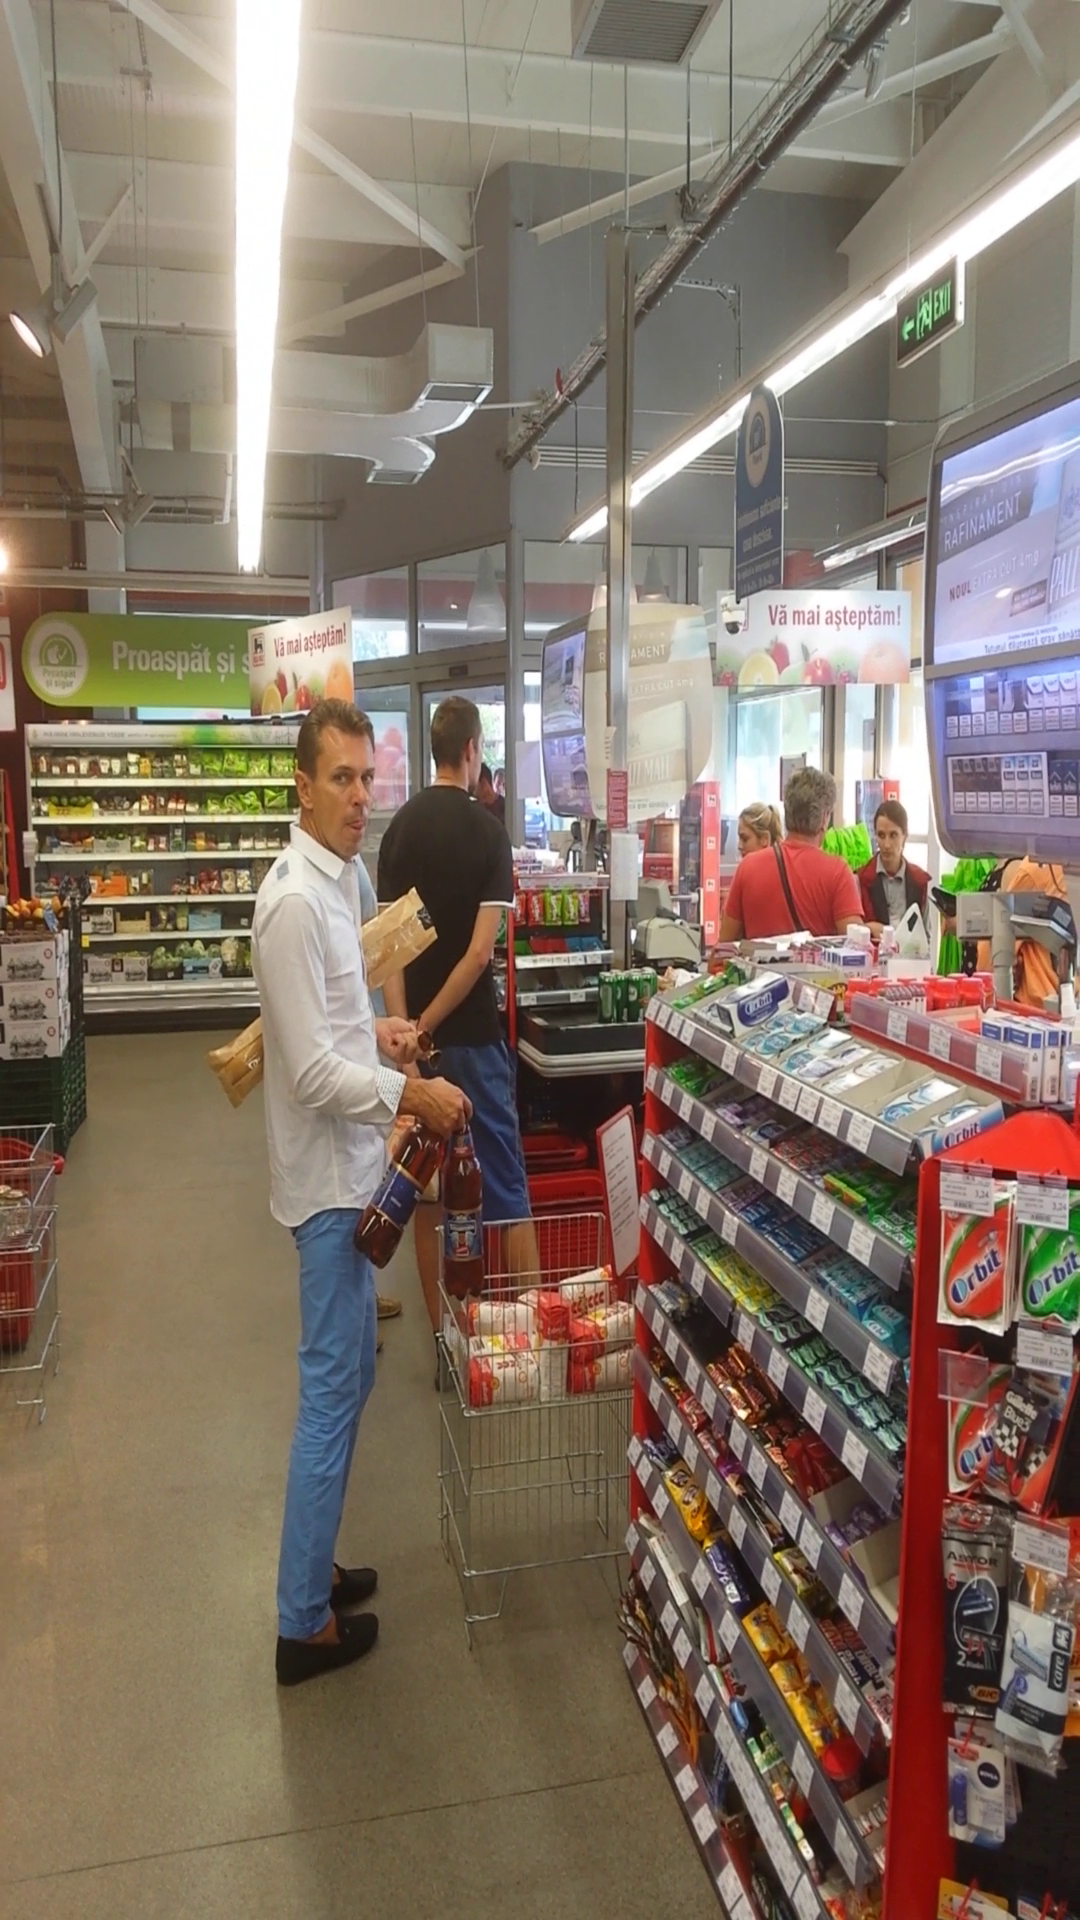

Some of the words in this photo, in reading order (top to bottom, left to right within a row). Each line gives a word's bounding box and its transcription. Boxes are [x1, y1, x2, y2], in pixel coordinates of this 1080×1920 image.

[934, 280, 951, 321] EXIT
[944, 491, 1022, 552] RAFINAMENT
[1001, 556, 1017, 577] CUT
[768, 604, 788, 626] Vă
[792, 604, 820, 626] mai
[274, 637, 285, 658] Vă
[286, 632, 303, 656] mai
[112, 641, 212, 680] Proaspăt
[216, 643, 236, 682] și
[944, 1121, 979, 1150] Orbit
[975, 1189, 990, 1199] 3,24
[951, 1247, 1002, 1304] Orbit
[1028, 1251, 1080, 1306] Orbit
[1005, 1390, 1038, 1421] Gillette
[960, 1436, 995, 1475] Orb
[956, 1651, 968, 1667] 2
[1052, 1656, 1065, 1689] care
